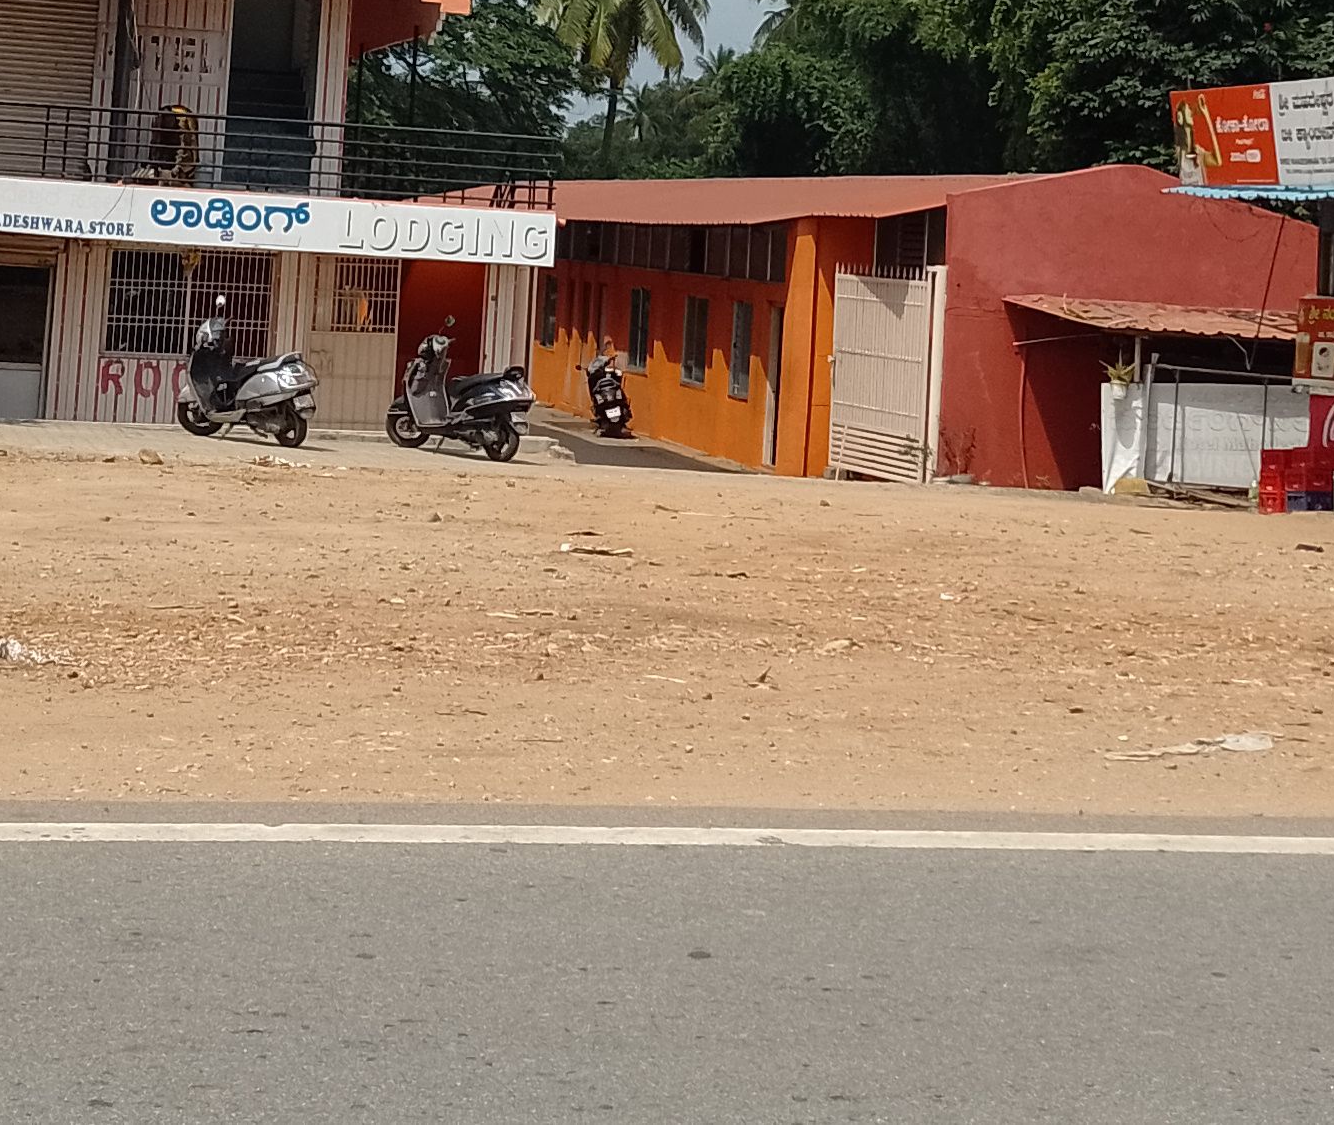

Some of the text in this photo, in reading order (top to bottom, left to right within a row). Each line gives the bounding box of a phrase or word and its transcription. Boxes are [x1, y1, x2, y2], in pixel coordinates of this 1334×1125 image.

[87, 220, 135, 238] STORE
[149, 196, 312, 243] ಲಾಡ್ಜಿಂಗ್
[338, 209, 549, 260] LODGING
